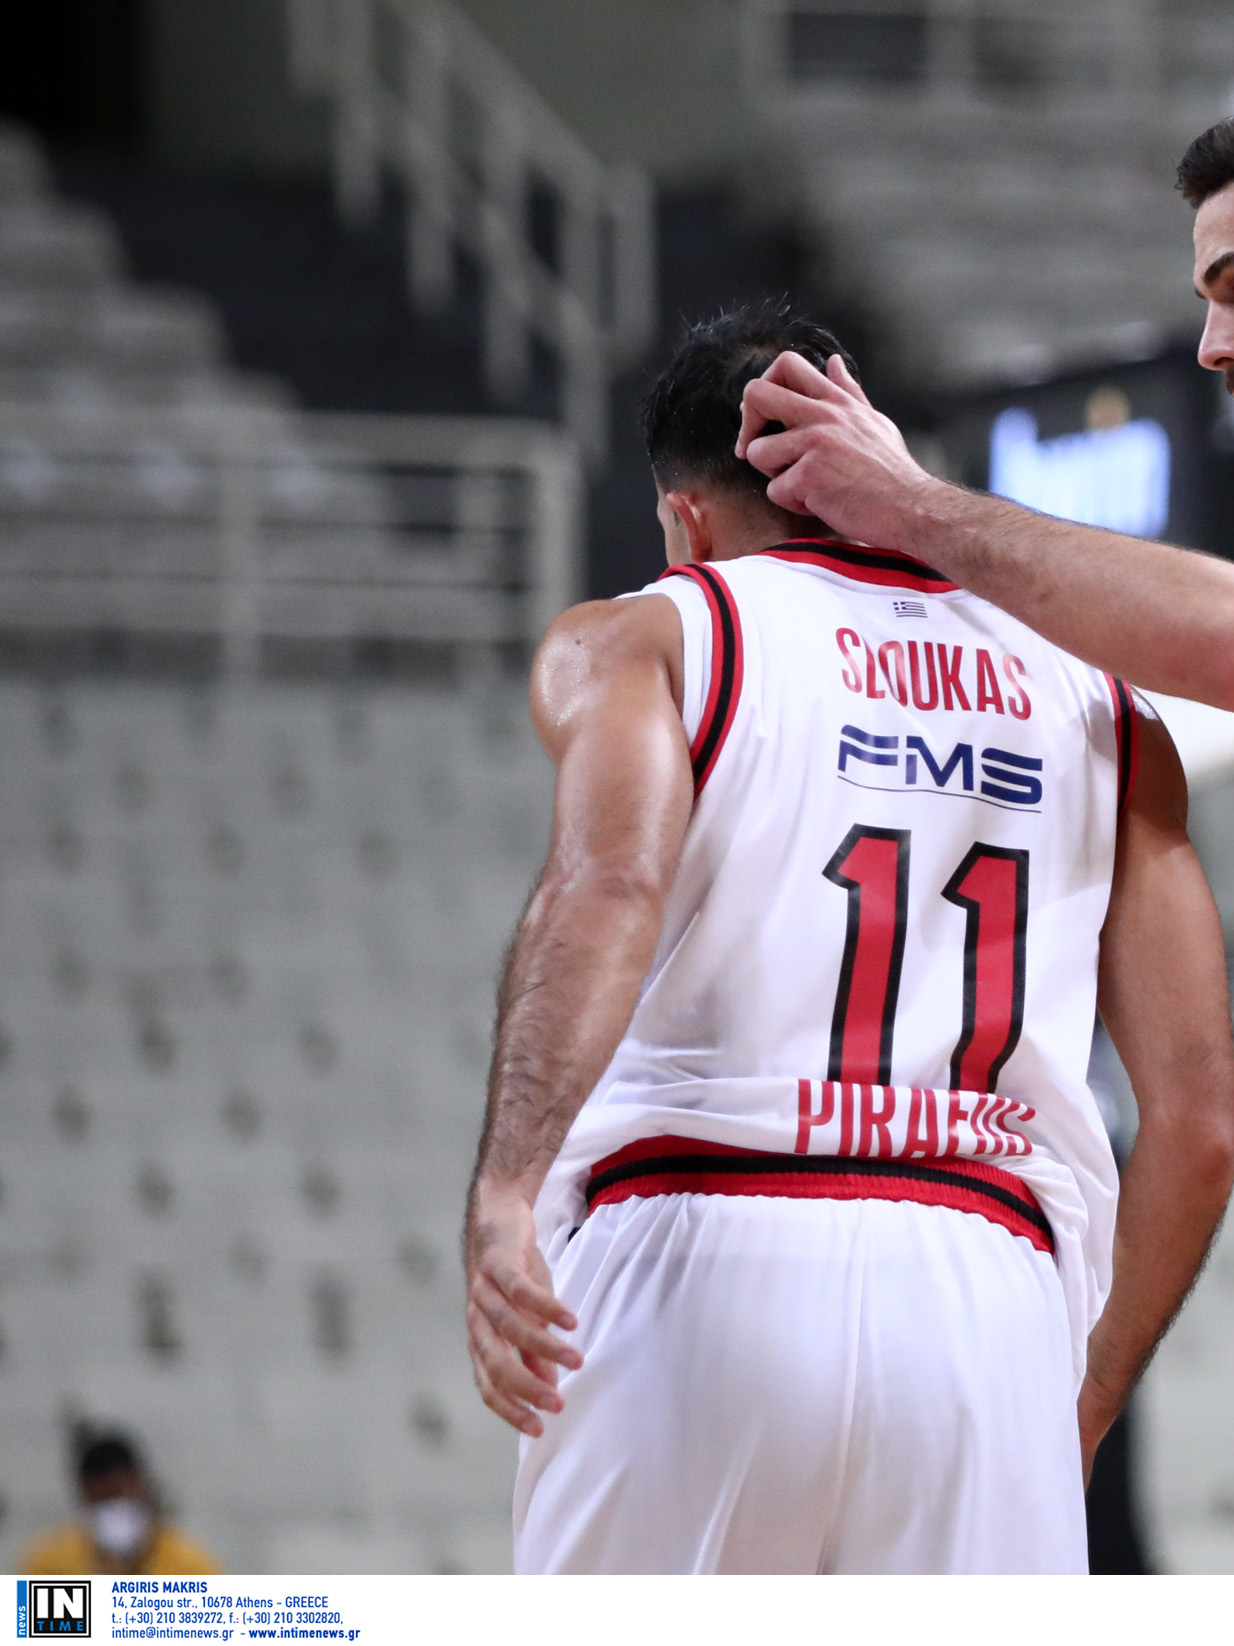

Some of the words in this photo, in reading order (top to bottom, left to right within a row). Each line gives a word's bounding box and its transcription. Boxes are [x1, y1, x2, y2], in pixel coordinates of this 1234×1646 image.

[835, 627, 1032, 721] SLOUKAS
[837, 724, 1043, 805] FMS
[822, 823, 1030, 1094] 11
